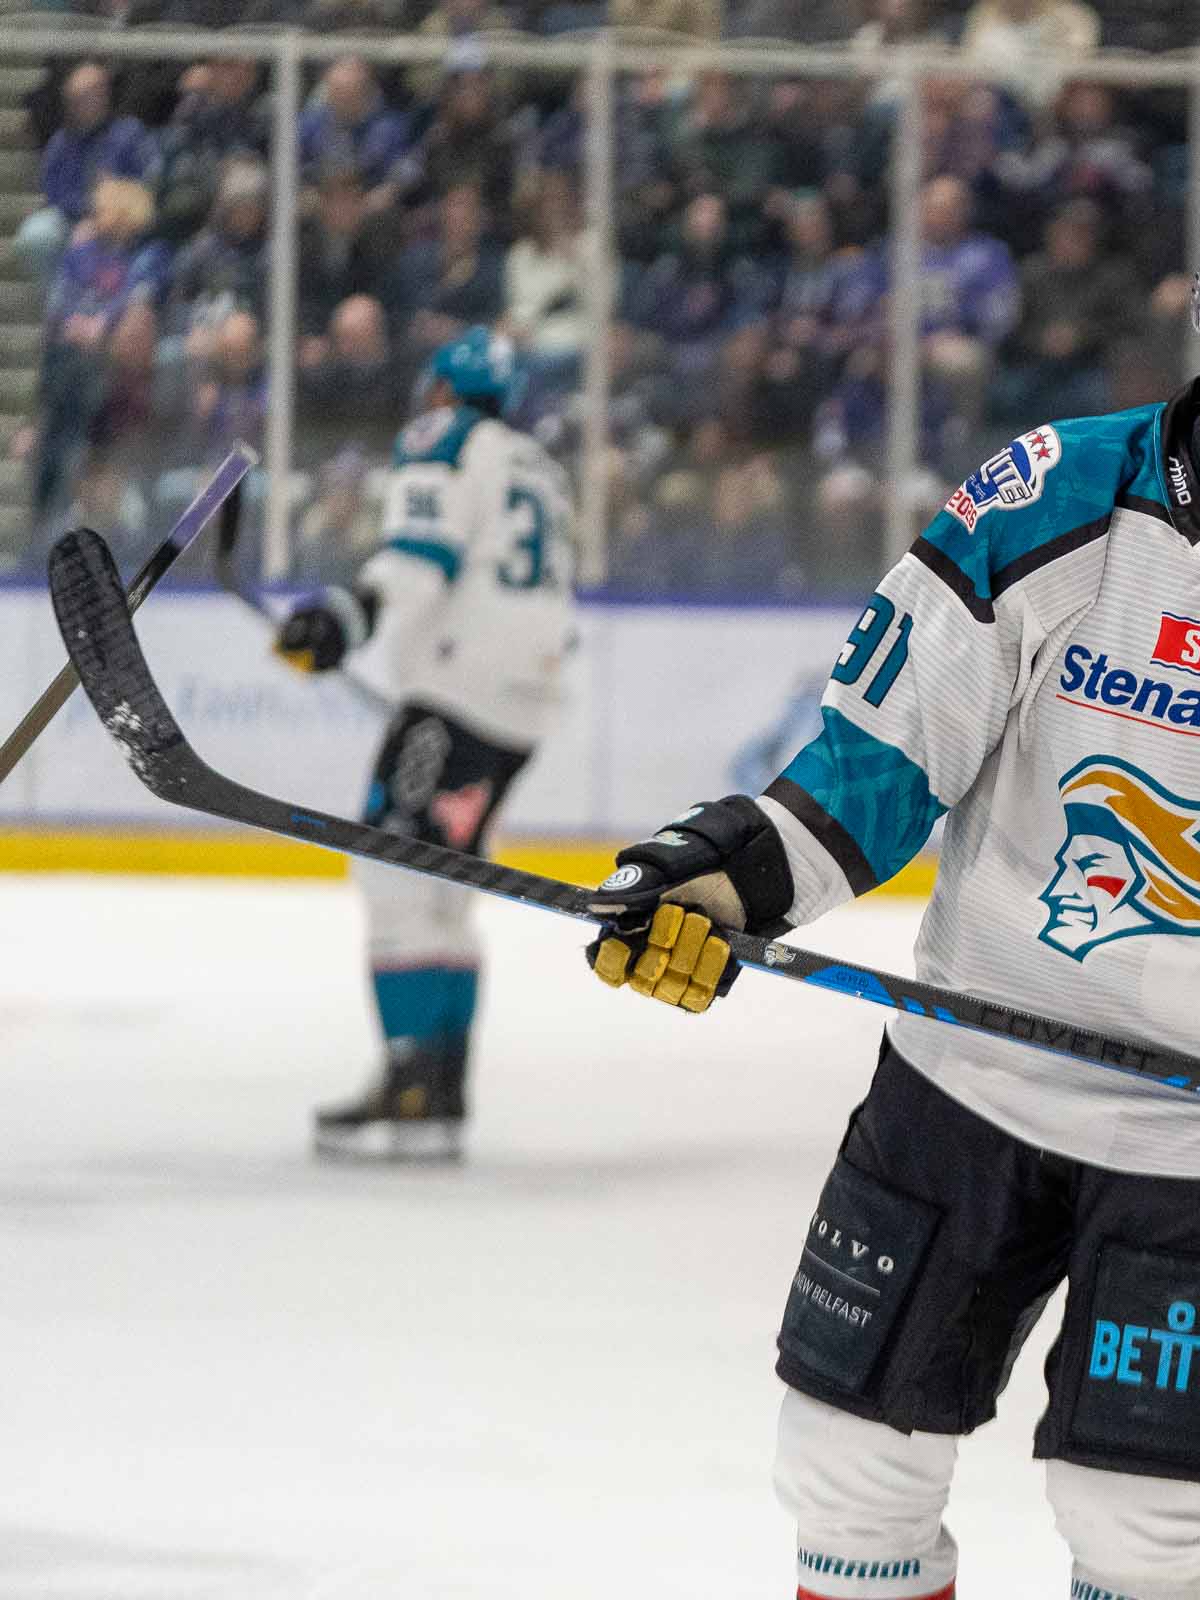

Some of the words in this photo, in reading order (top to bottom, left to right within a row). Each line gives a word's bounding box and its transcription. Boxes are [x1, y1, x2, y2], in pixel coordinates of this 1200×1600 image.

[1168, 456, 1192, 506] rhino
[831, 591, 914, 709] 91
[978, 1003, 1158, 1073] COVERT
[811, 1284, 872, 1328] BELFAST
